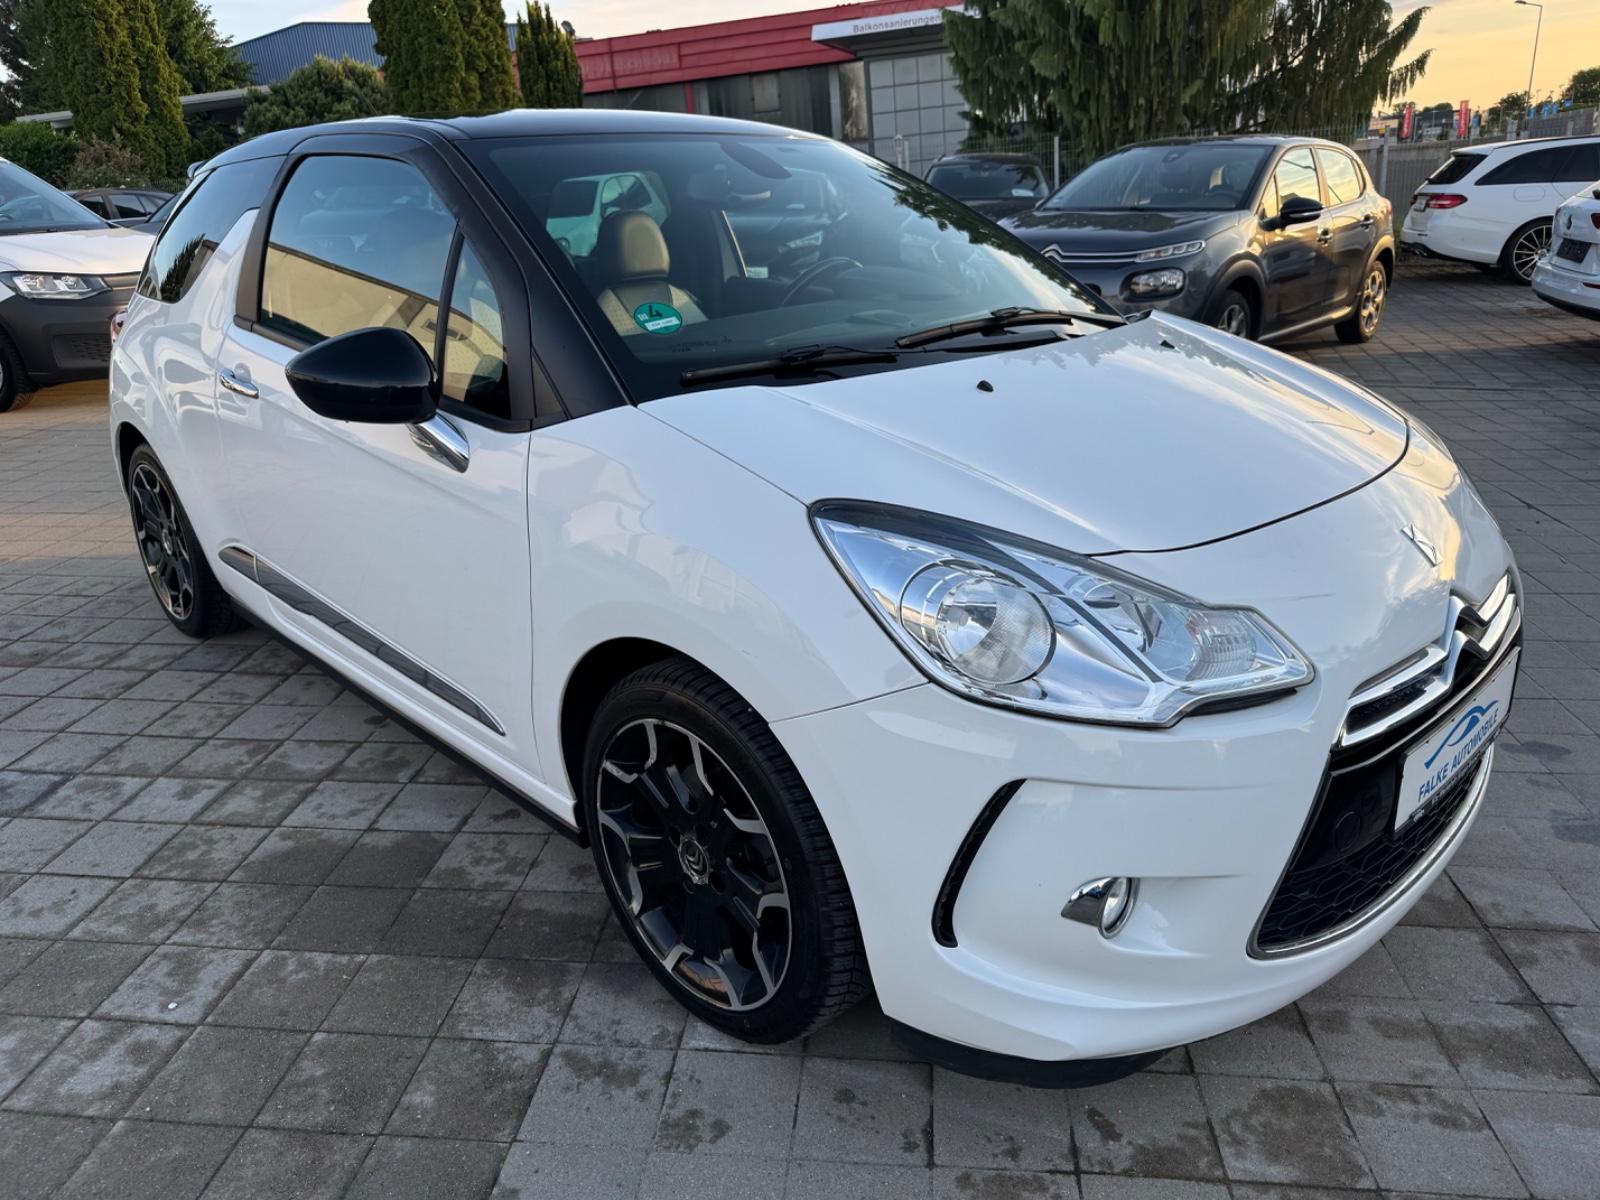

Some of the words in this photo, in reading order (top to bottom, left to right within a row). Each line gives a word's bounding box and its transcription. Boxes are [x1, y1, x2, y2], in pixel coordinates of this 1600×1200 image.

[852, 14, 941, 33] Balkonsanierungen
[1418, 764, 1449, 802] FALKE
[1450, 708, 1499, 773] AUTOMOBILE
